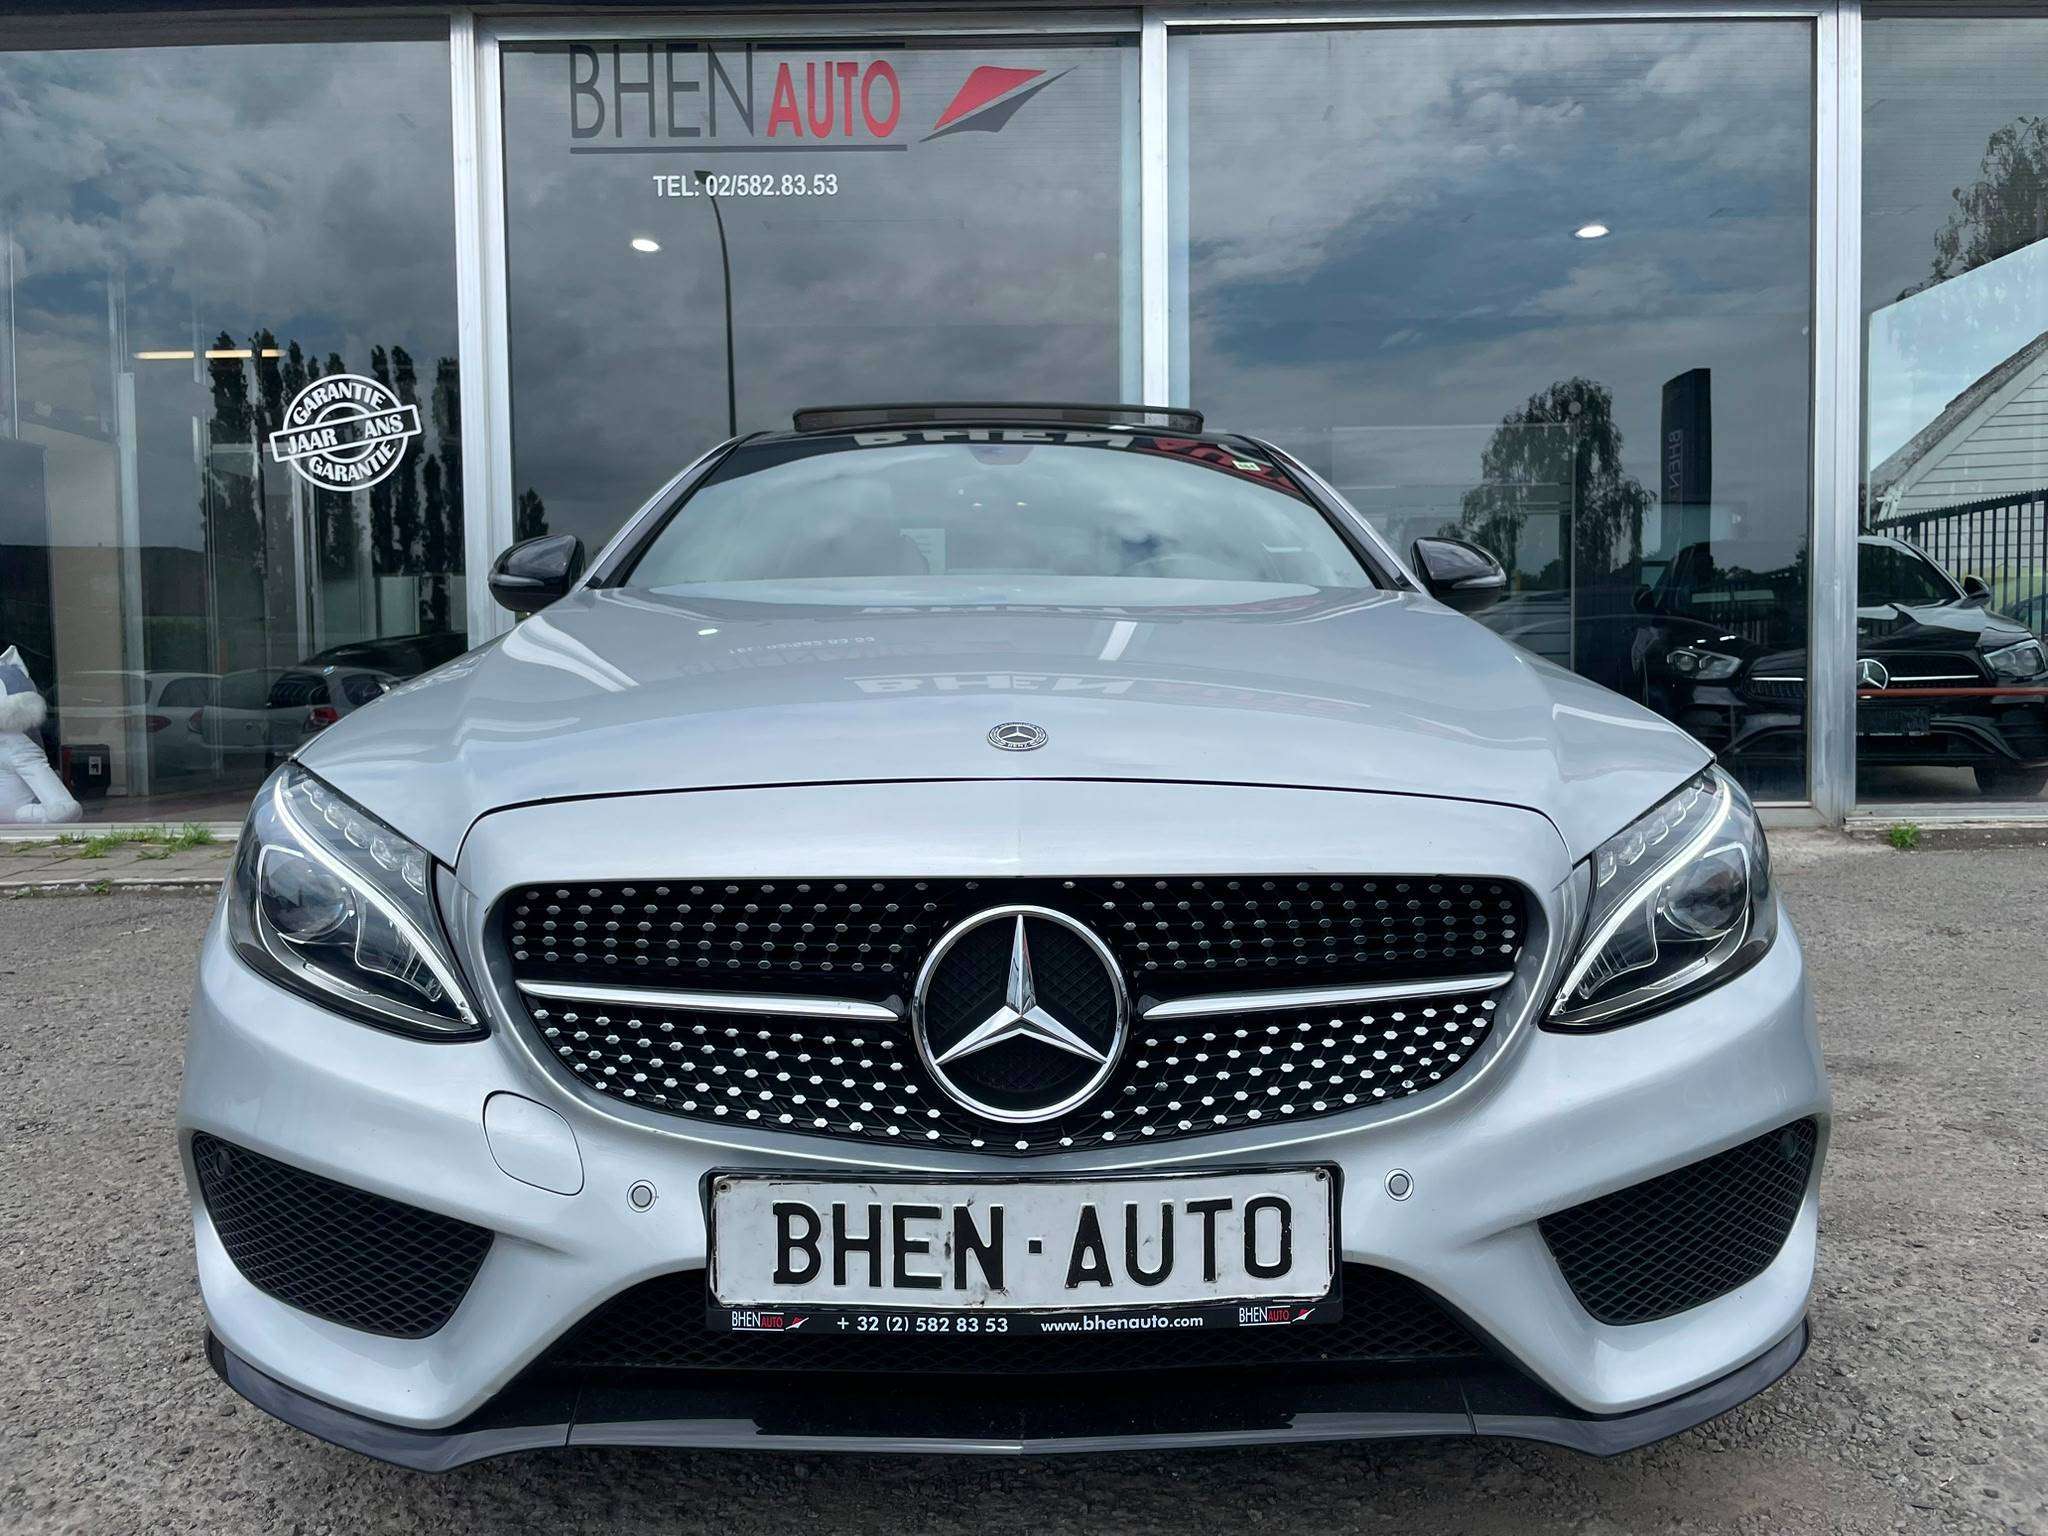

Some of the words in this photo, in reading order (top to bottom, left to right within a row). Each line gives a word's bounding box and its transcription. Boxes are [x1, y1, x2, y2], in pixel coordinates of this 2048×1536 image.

[652, 175, 700, 197] TEL:
[705, 174, 838, 197] 02/582.83.53
[292, 381, 386, 425] GARANTIE
[287, 428, 338, 455] JAAR
[364, 414, 404, 439] ANS
[308, 440, 397, 482] GARANTIE
[773, 1202, 1004, 1290] BHEN
[1065, 1195, 1293, 1288] AUTO
[857, 1316, 879, 1331] 32
[886, 1316, 909, 1332] (2)
[916, 1317, 950, 1332] 582
[956, 1317, 979, 1332] 83
[985, 1317, 1009, 1332] 53
[1041, 1314, 1204, 1332] www.bhenauto.com
